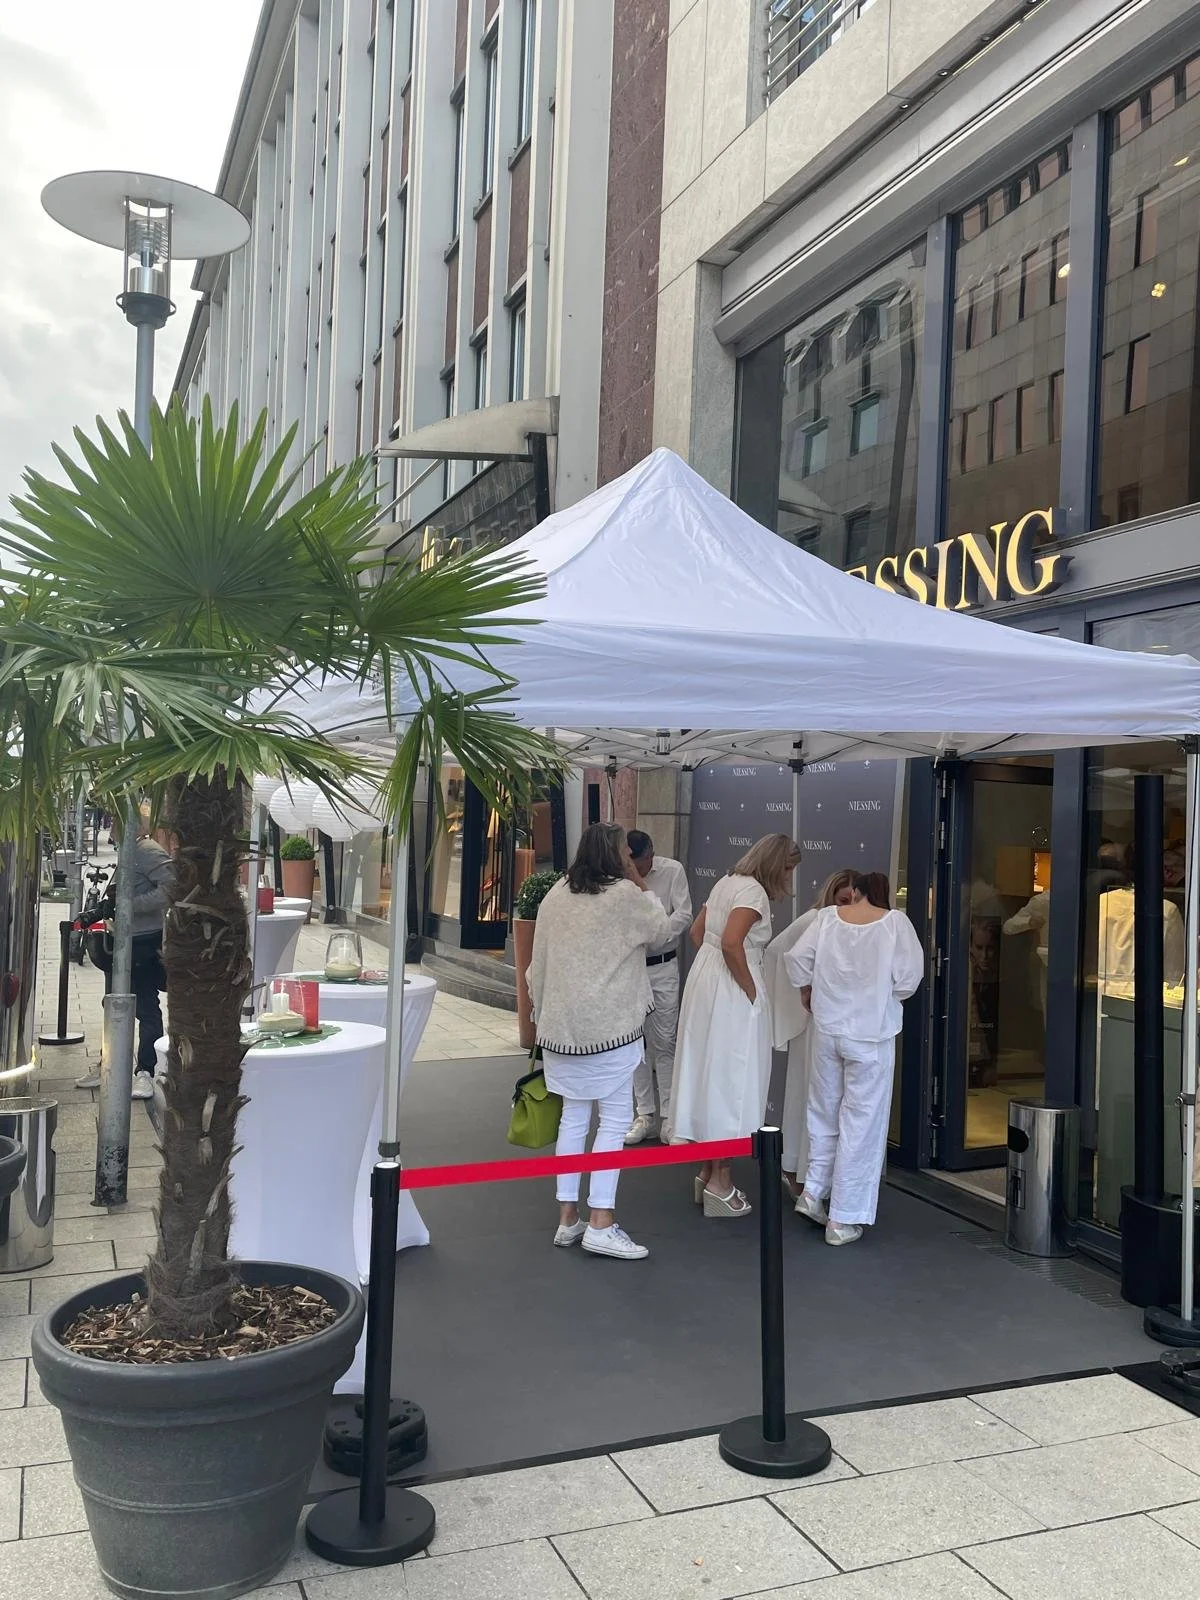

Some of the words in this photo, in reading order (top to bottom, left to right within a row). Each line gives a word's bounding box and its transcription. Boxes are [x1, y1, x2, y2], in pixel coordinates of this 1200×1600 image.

[732, 767, 757, 776] NIESSING
[806, 762, 837, 773] NIESSING
[766, 802, 792, 812] NIESSING
[848, 800, 880, 811] NIESSING
[802, 840, 832, 850] NIESSING
